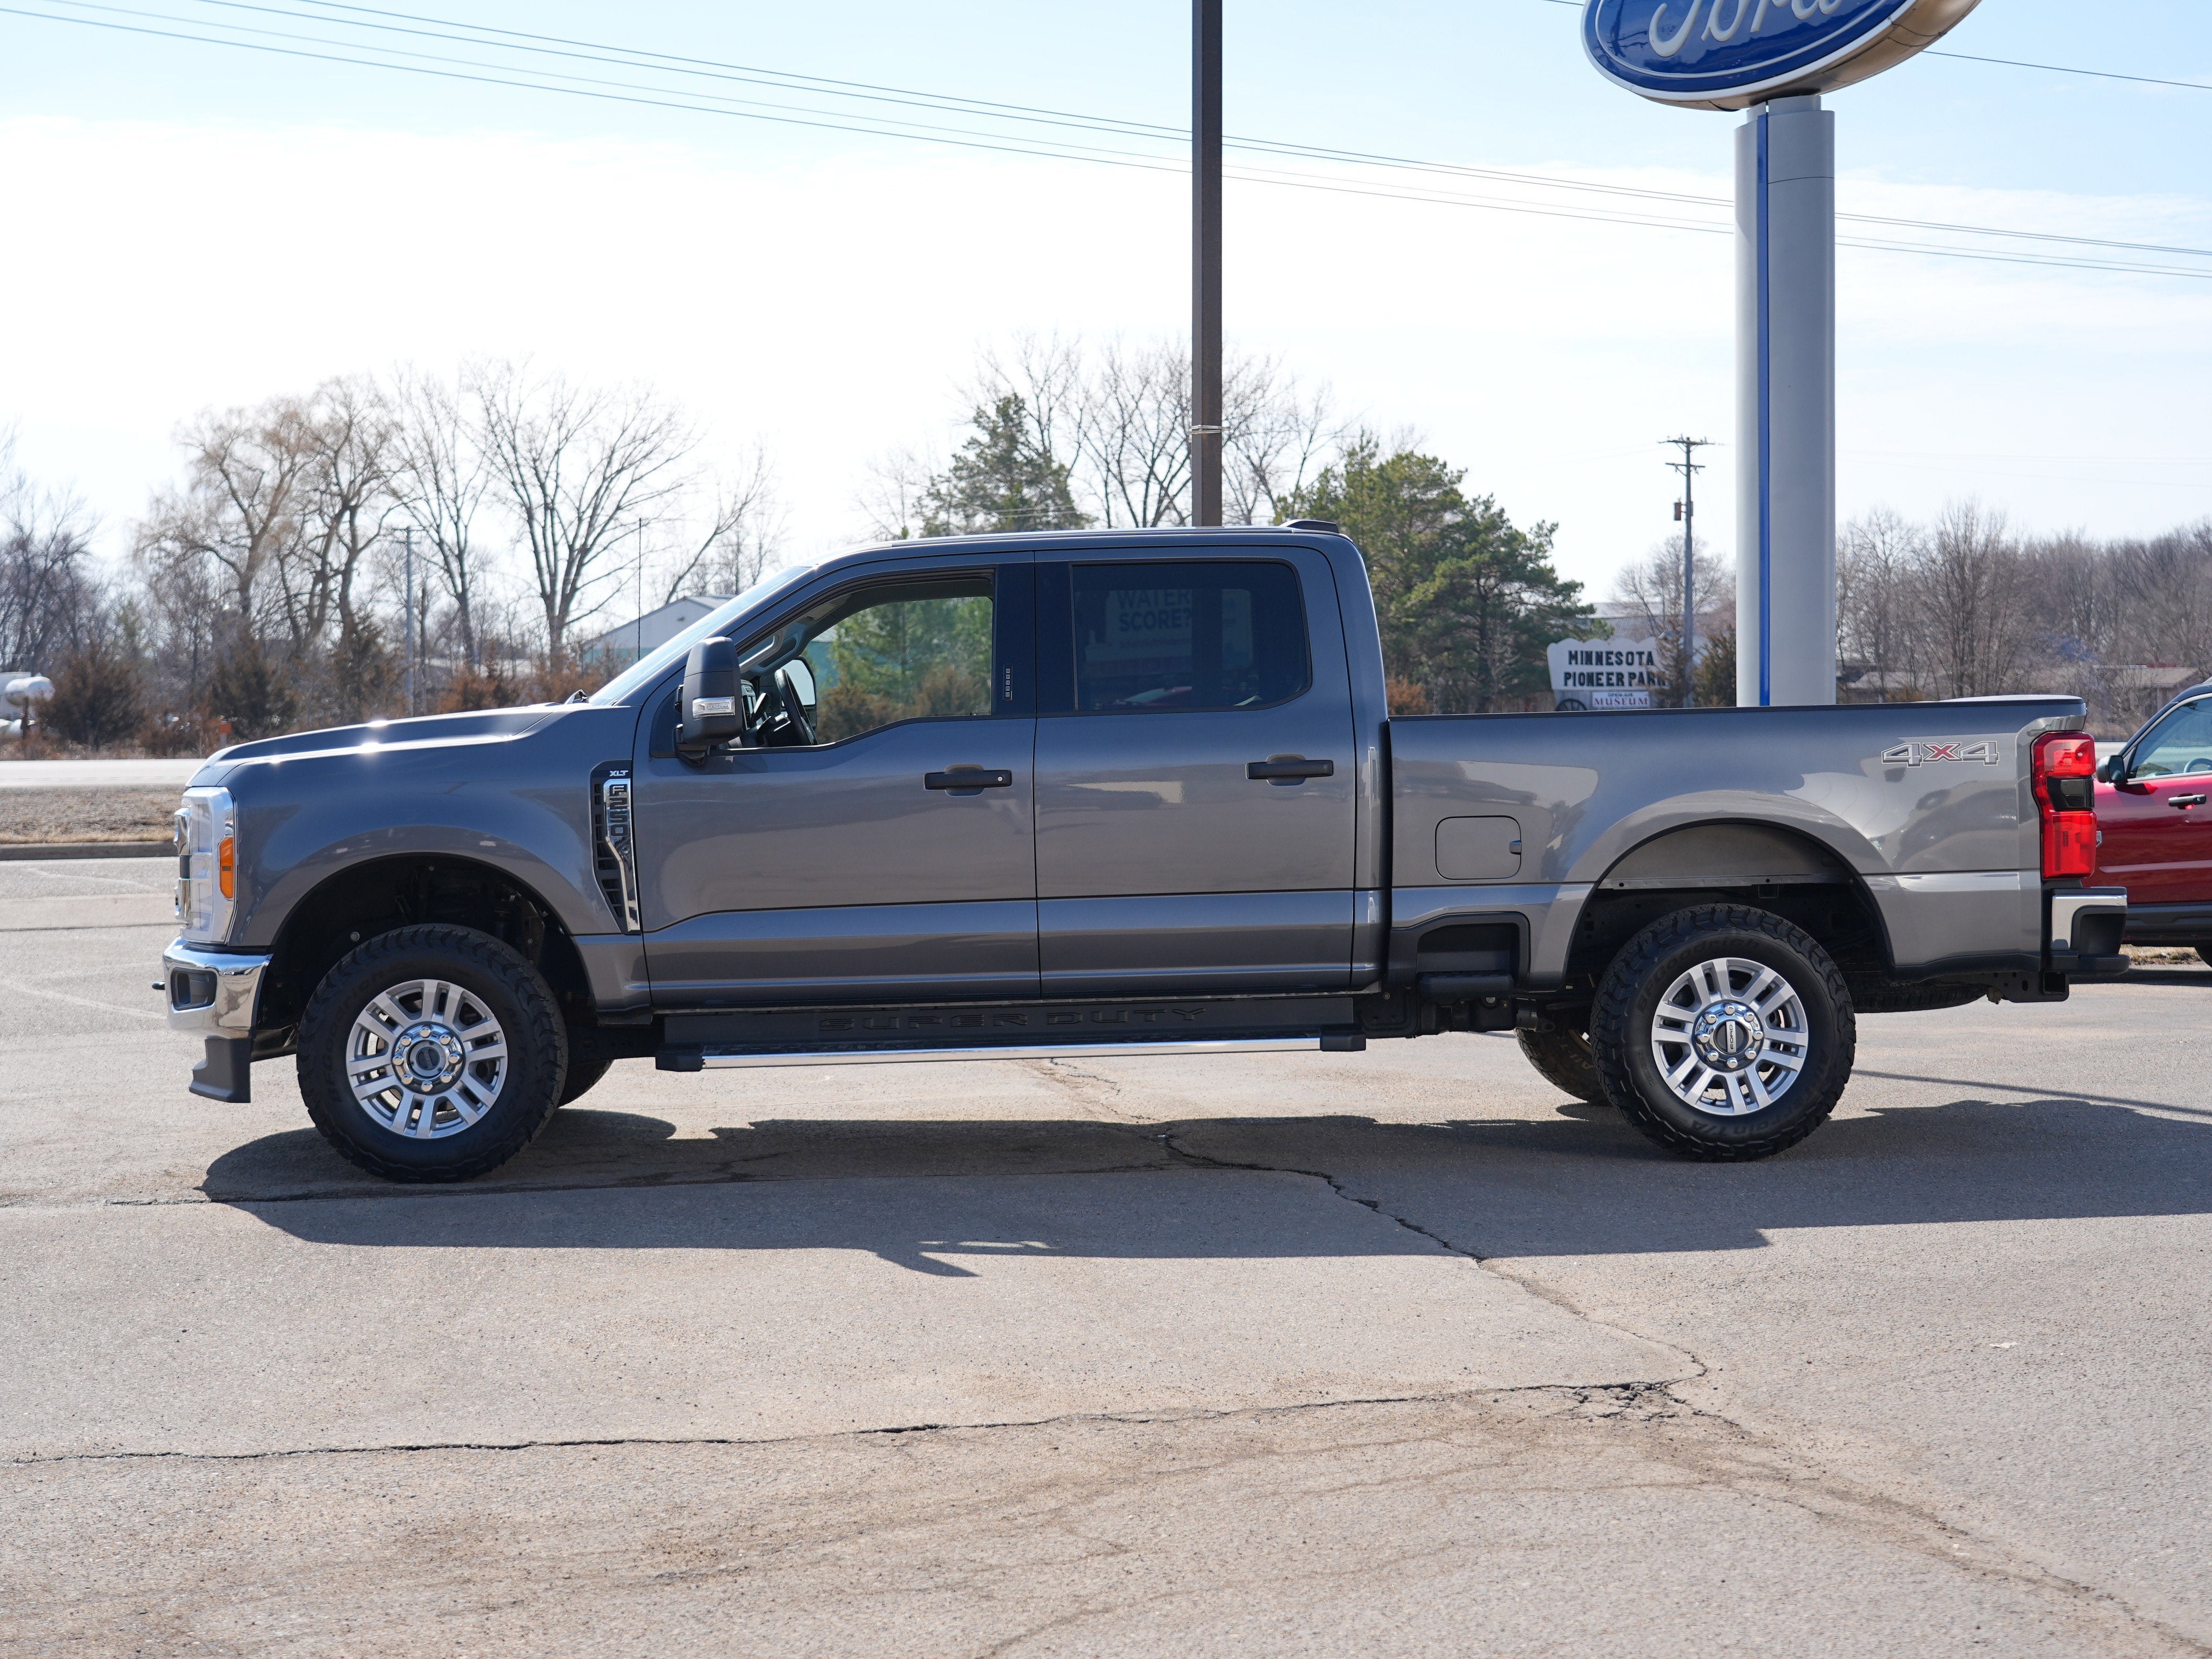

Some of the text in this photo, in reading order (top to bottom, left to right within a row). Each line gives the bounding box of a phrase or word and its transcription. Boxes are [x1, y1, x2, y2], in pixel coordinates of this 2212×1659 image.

[1649, 0, 1842, 57] For
[1117, 589, 1191, 609] WATER
[1568, 650, 1654, 665] MINNESOTA
[1563, 672, 1624, 686] PIONEER
[1635, 937, 1759, 1013] BFGoodrich
[819, 1007, 1207, 1031] SUPER DUTY
[1691, 1121, 1727, 1136] T/A
